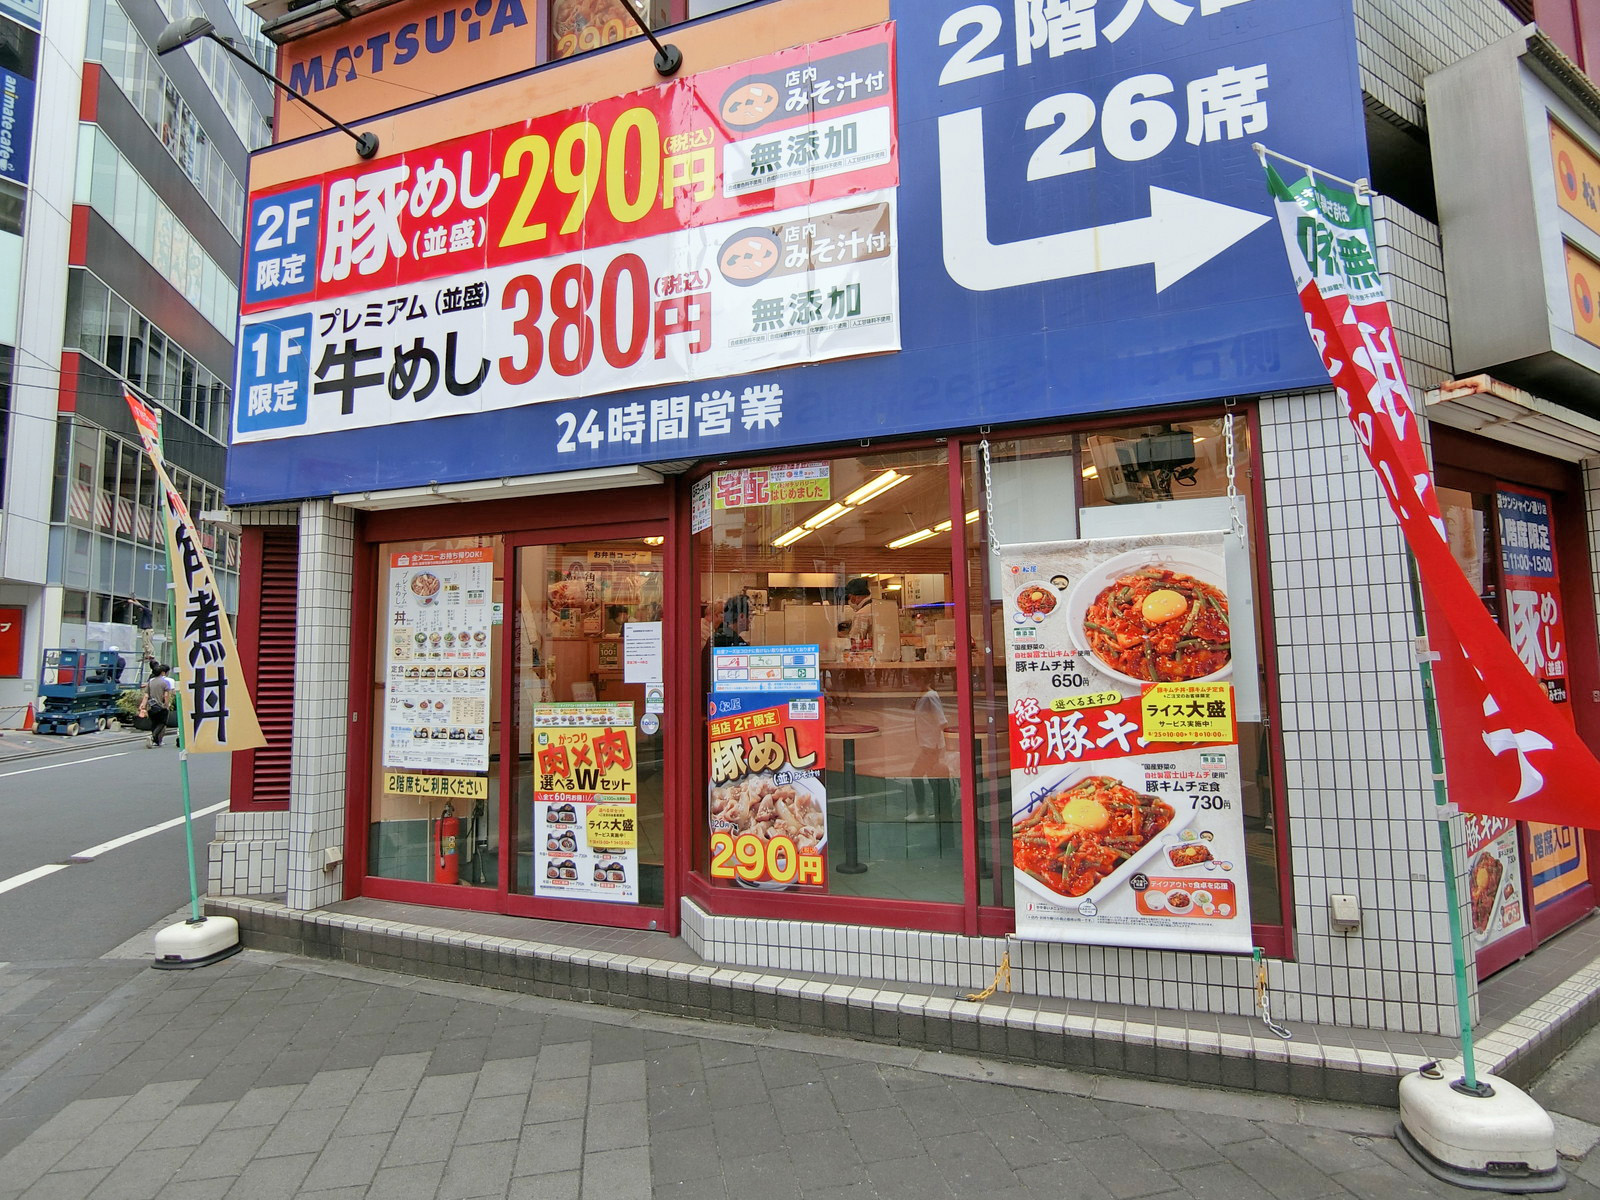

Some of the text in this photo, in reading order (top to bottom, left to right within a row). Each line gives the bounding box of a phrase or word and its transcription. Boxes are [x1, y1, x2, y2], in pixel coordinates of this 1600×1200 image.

[286, 0, 529, 102] MATSUYA
[784, 66, 818, 88] 店内
[784, 70, 885, 113] みそ汁付
[1024, 63, 1270, 181] 26席
[750, 122, 859, 177] 無添加
[254, 198, 315, 253] 2F
[320, 150, 501, 282] 豚めし
[784, 222, 817, 244] 店内
[412, 216, 488, 261] (並盛)
[784, 230, 888, 269] みそ汁付
[254, 253, 307, 292] 限定
[319, 293, 428, 338] プレミアム
[751, 282, 861, 333] 無添加
[251, 326, 305, 377] 1F
[313, 330, 492, 416] 牛めし
[247, 379, 299, 417] 限定
[555, 383, 785, 455] 24時間営業
[716, 470, 770, 507] 宅配
[770, 485, 824, 501] はじめました
[593, 551, 647, 560] お弁当コーナー
[394, 610, 407, 626] 丼
[1015, 660, 1076, 673] 豚キムチ丼
[791, 702, 816, 711] 無添加
[1055, 692, 1116, 710] 選べる玉子の
[1146, 699, 1227, 718] ライス大盛
[558, 732, 588, 746] がっつり
[709, 726, 817, 782] 豚めし
[388, 774, 484, 796] 2階席もご利用ください
[1145, 780, 1221, 793] 豚キムチ定食
[588, 818, 635, 832] ライス大盛
